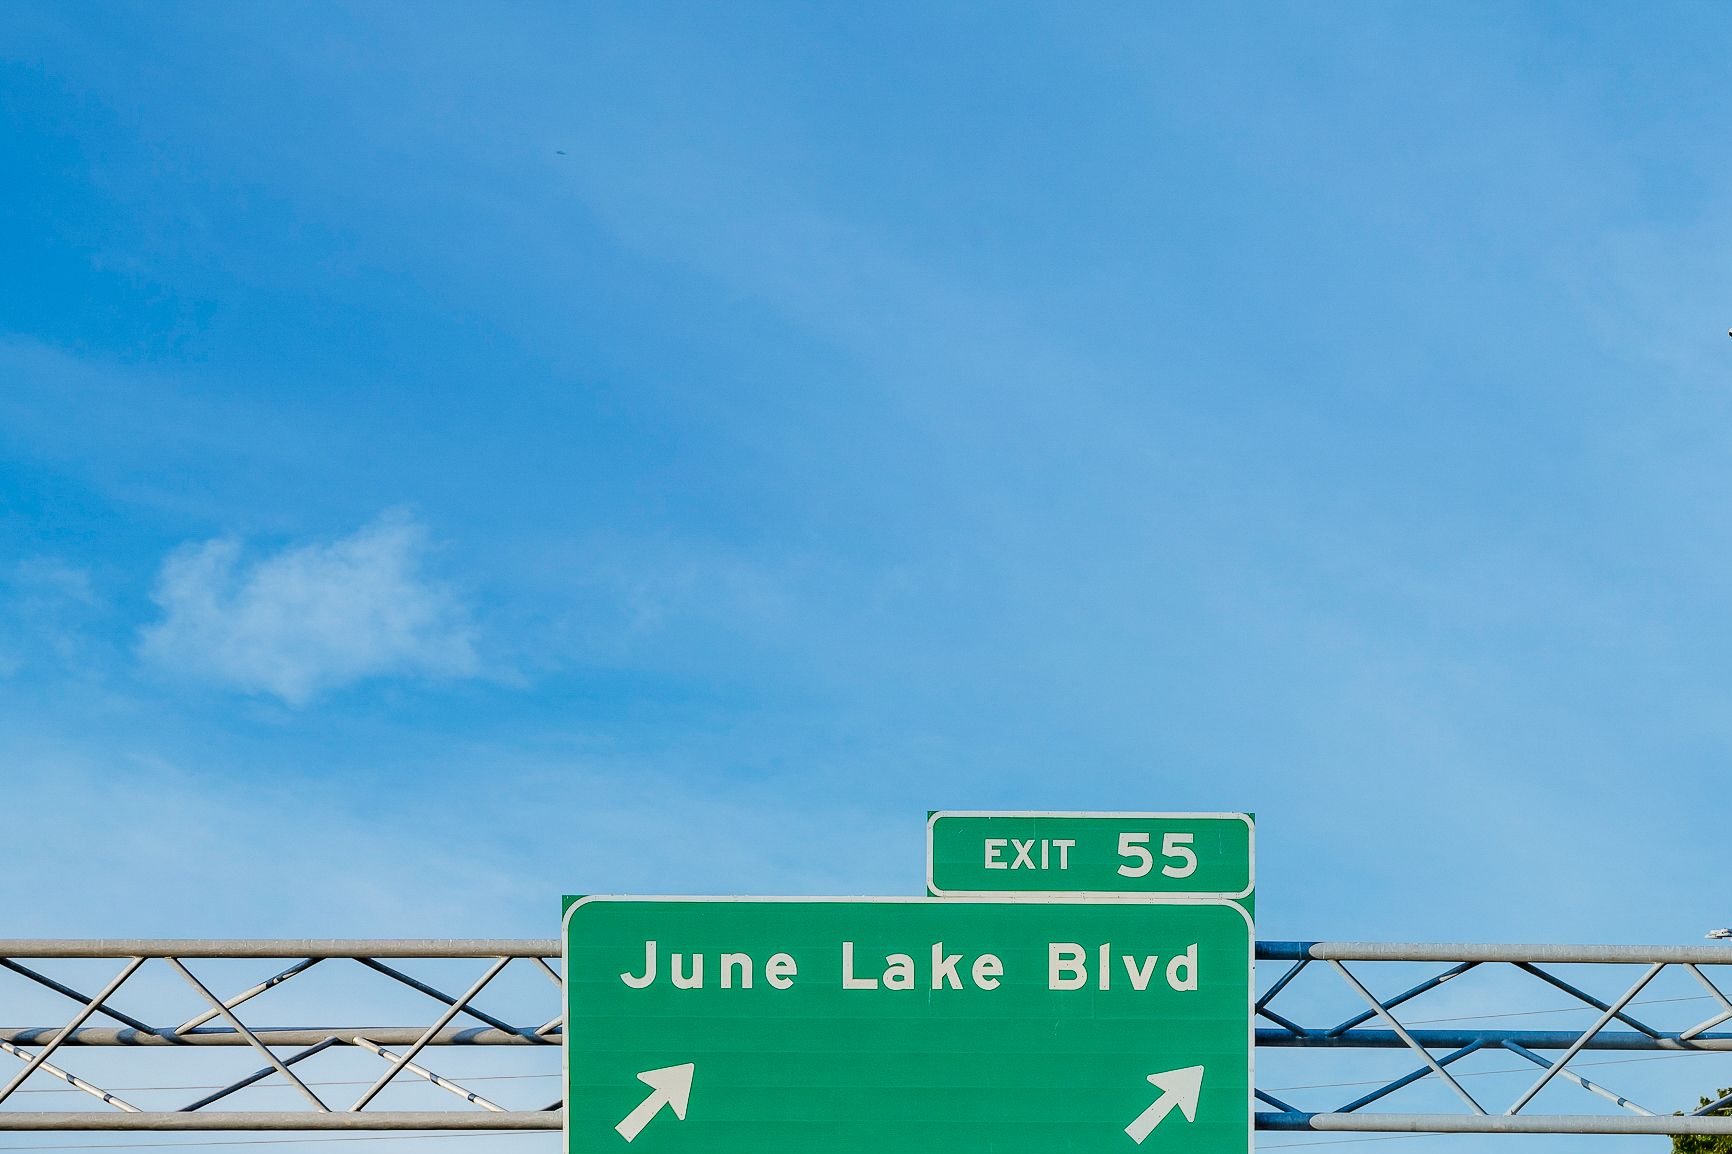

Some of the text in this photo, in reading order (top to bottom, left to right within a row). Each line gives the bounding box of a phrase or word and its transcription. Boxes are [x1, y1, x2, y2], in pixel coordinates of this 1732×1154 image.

[984, 832, 1198, 879] EXIT 55
[619, 940, 1199, 991] June Lake Blvd
